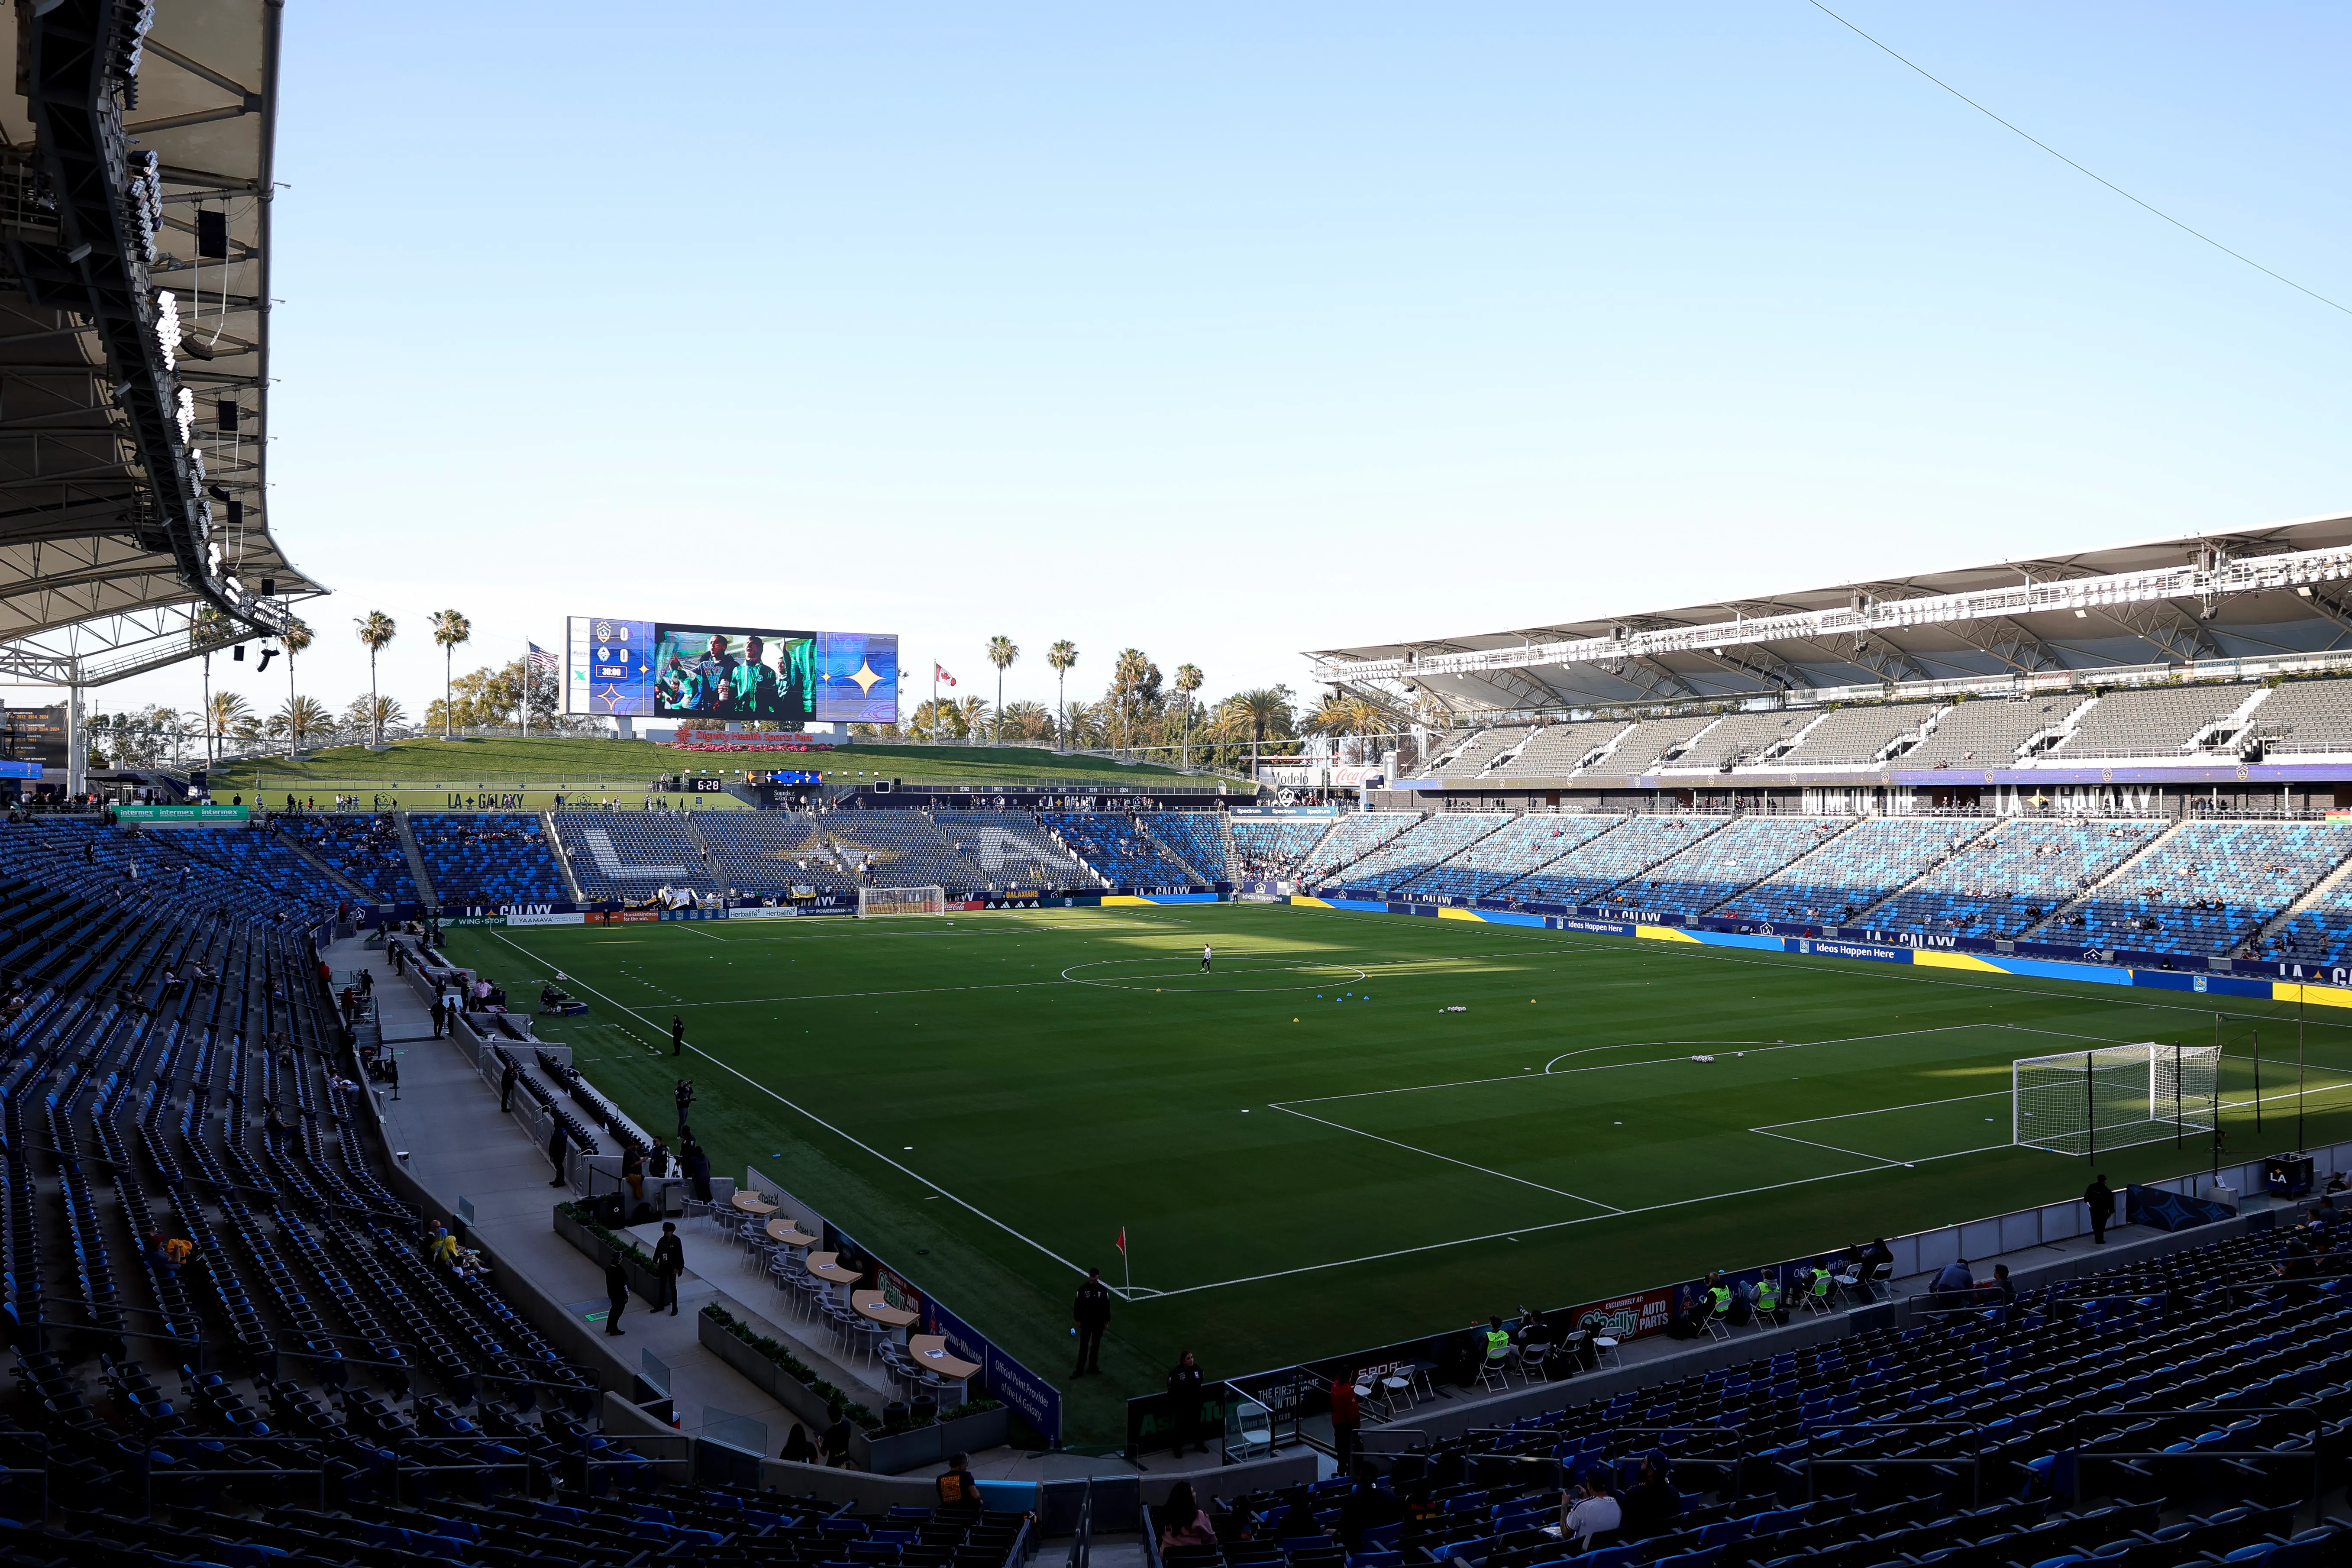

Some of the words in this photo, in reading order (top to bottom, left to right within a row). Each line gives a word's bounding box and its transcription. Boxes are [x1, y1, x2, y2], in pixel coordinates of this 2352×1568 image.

[620, 627, 628, 641] 0
[620, 649, 628, 663] 0
[602, 668, 621, 676] 30:00
[696, 731, 730, 741] Dignity
[731, 731, 762, 741] Health
[765, 732, 793, 742] Sports
[795, 733, 814, 742] Park
[1271, 771, 1308, 785] Modelo
[698, 781, 718, 790] 6:28
[448, 793, 462, 809] LA
[1802, 786, 1850, 815] HOME
[1855, 786, 1877, 815] OF
[1883, 785, 1917, 815] THE
[1995, 784, 2023, 817] LA
[2054, 784, 2152, 816] GALAXY
[730, 909, 758, 917] Herbalife
[766, 908, 793, 916] Herbalife
[1568, 921, 1583, 929] Ideas
[1585, 921, 1607, 932] Happen
[1608, 924, 1623, 933] Here
[1816, 943, 1838, 954] Ideas
[1840, 945, 1873, 958] Happen
[1874, 949, 1895, 959] Here
[2270, 1172, 2287, 1183] LA
[907, 1294, 918, 1313] AUTO
[1605, 1297, 1635, 1309] EXCLUSIVELY
[1642, 1300, 1666, 1317] AUTO
[1639, 1312, 1668, 1331] PARTS
[995, 1360, 1012, 1380] Official
[1013, 1373, 1026, 1391] Paint
[1026, 1381, 1049, 1408] Provider
[1258, 1388, 1273, 1400] THE
[1001, 1383, 1007, 1391] of
[1015, 1391, 1022, 1404] LA
[1022, 1398, 1043, 1422] Galaxy.
[1275, 1398, 1282, 1410] IN
